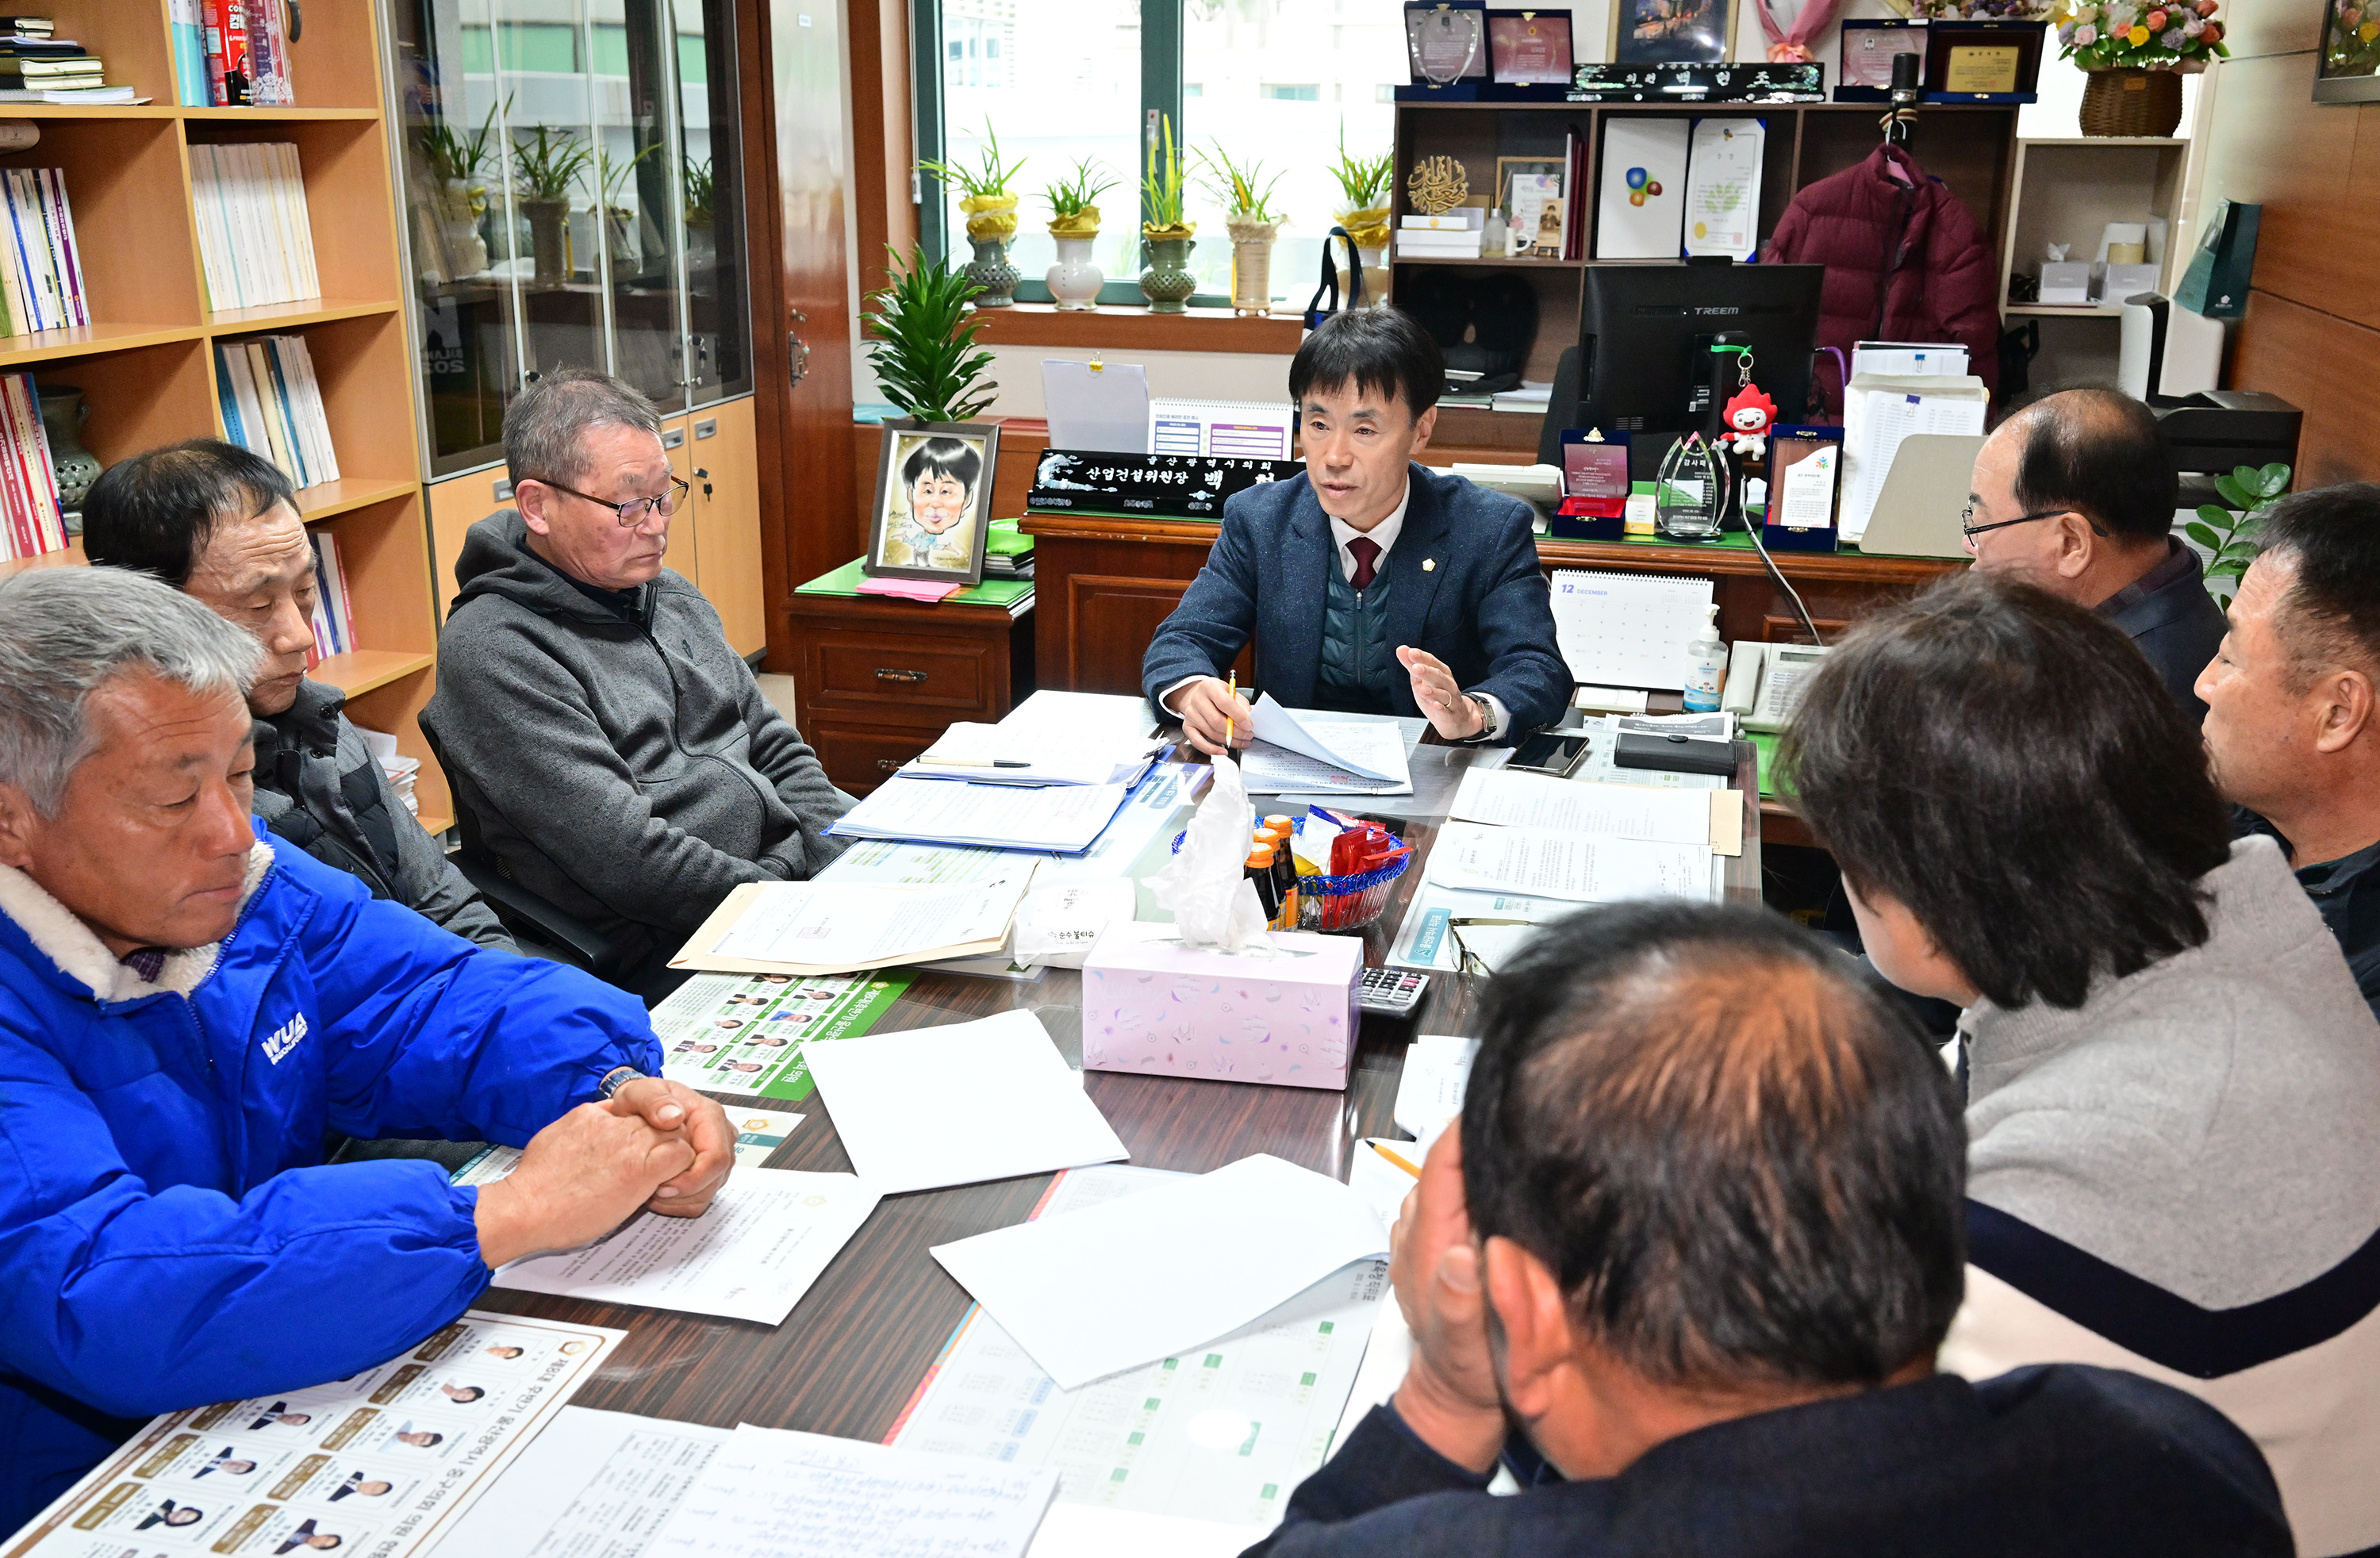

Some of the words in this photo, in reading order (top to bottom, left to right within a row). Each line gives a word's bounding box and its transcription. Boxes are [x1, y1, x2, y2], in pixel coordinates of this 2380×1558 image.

[1086, 466, 1189, 485] 산업건설위원장
[1146, 455, 1273, 472] 울산광역시의회
[1561, 584, 1575, 593] 12
[1420, 927, 1438, 948] 울산광역시
[1429, 915, 1442, 927] 직위표
[841, 988, 881, 1021] 제8대(후반기)
[261, 1012, 306, 1058] WUA
[781, 1070, 803, 1083] 의원
[537, 1359, 569, 1383] 제8대
[508, 1385, 543, 1413] 후반기
[459, 1416, 515, 1465] 울산광역시
[416, 1468, 466, 1511] 중구의회
[390, 1514, 423, 1537] 의원
